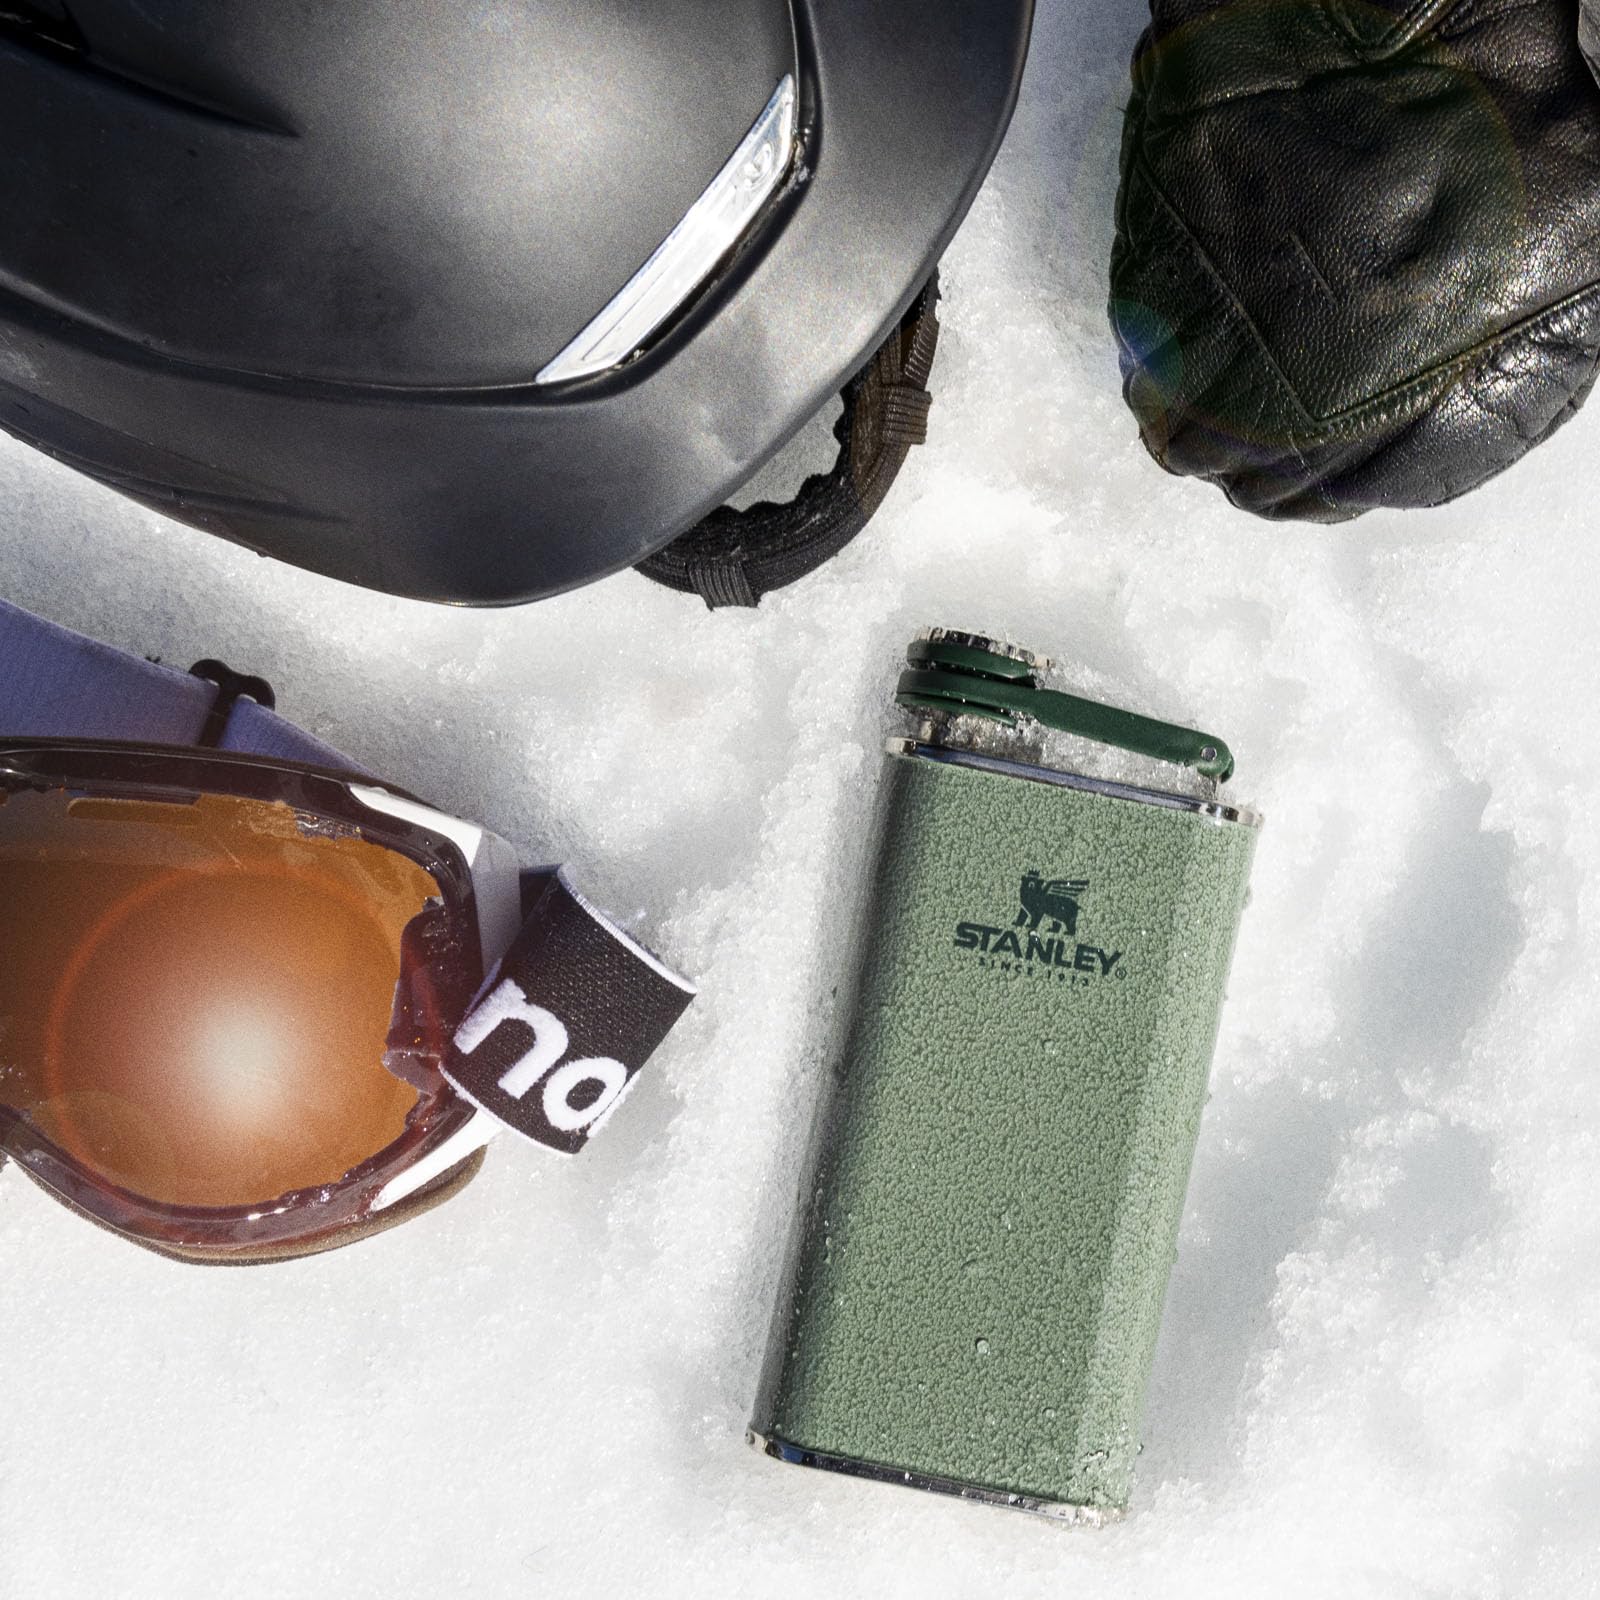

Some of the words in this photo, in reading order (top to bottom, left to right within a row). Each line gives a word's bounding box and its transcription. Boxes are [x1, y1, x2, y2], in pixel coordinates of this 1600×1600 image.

[978, 957, 1034, 976] SINCE
[1047, 970, 1089, 986] 1913
[453, 978, 640, 1138] no
